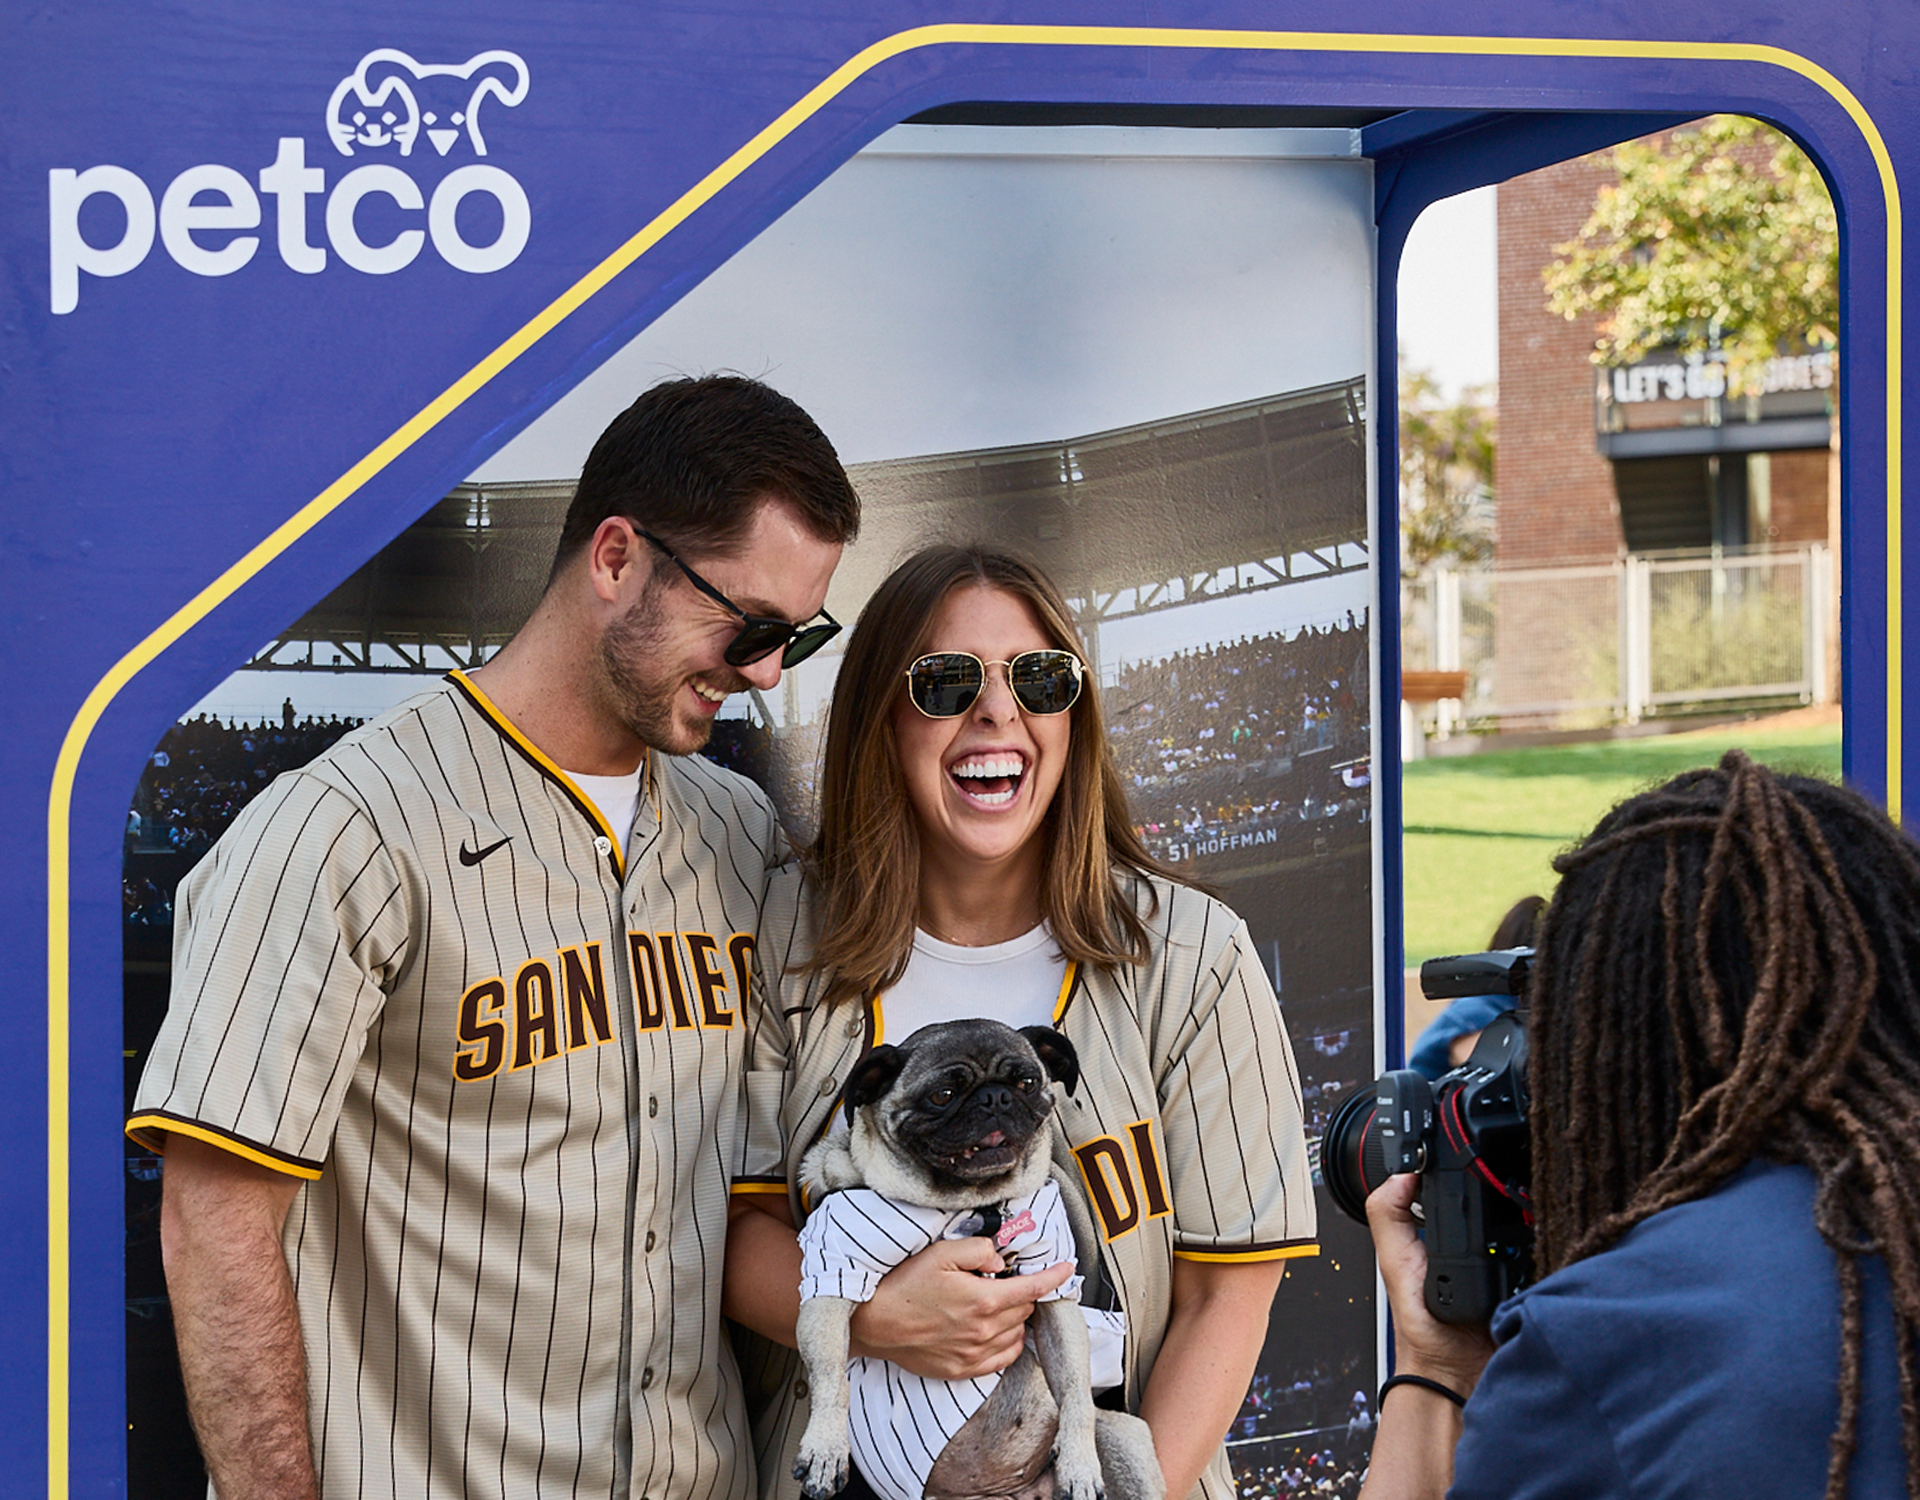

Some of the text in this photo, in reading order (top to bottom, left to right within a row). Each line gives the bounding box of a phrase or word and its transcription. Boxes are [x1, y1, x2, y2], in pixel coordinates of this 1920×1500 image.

[49, 137, 532, 315] petco
[1168, 842, 1190, 862] 51
[1195, 828, 1277, 856] HOFFMAN
[452, 940, 616, 1083] SAN
[1000, 1216, 1031, 1239] GRACIE
[1069, 1118, 1174, 1245] DI
